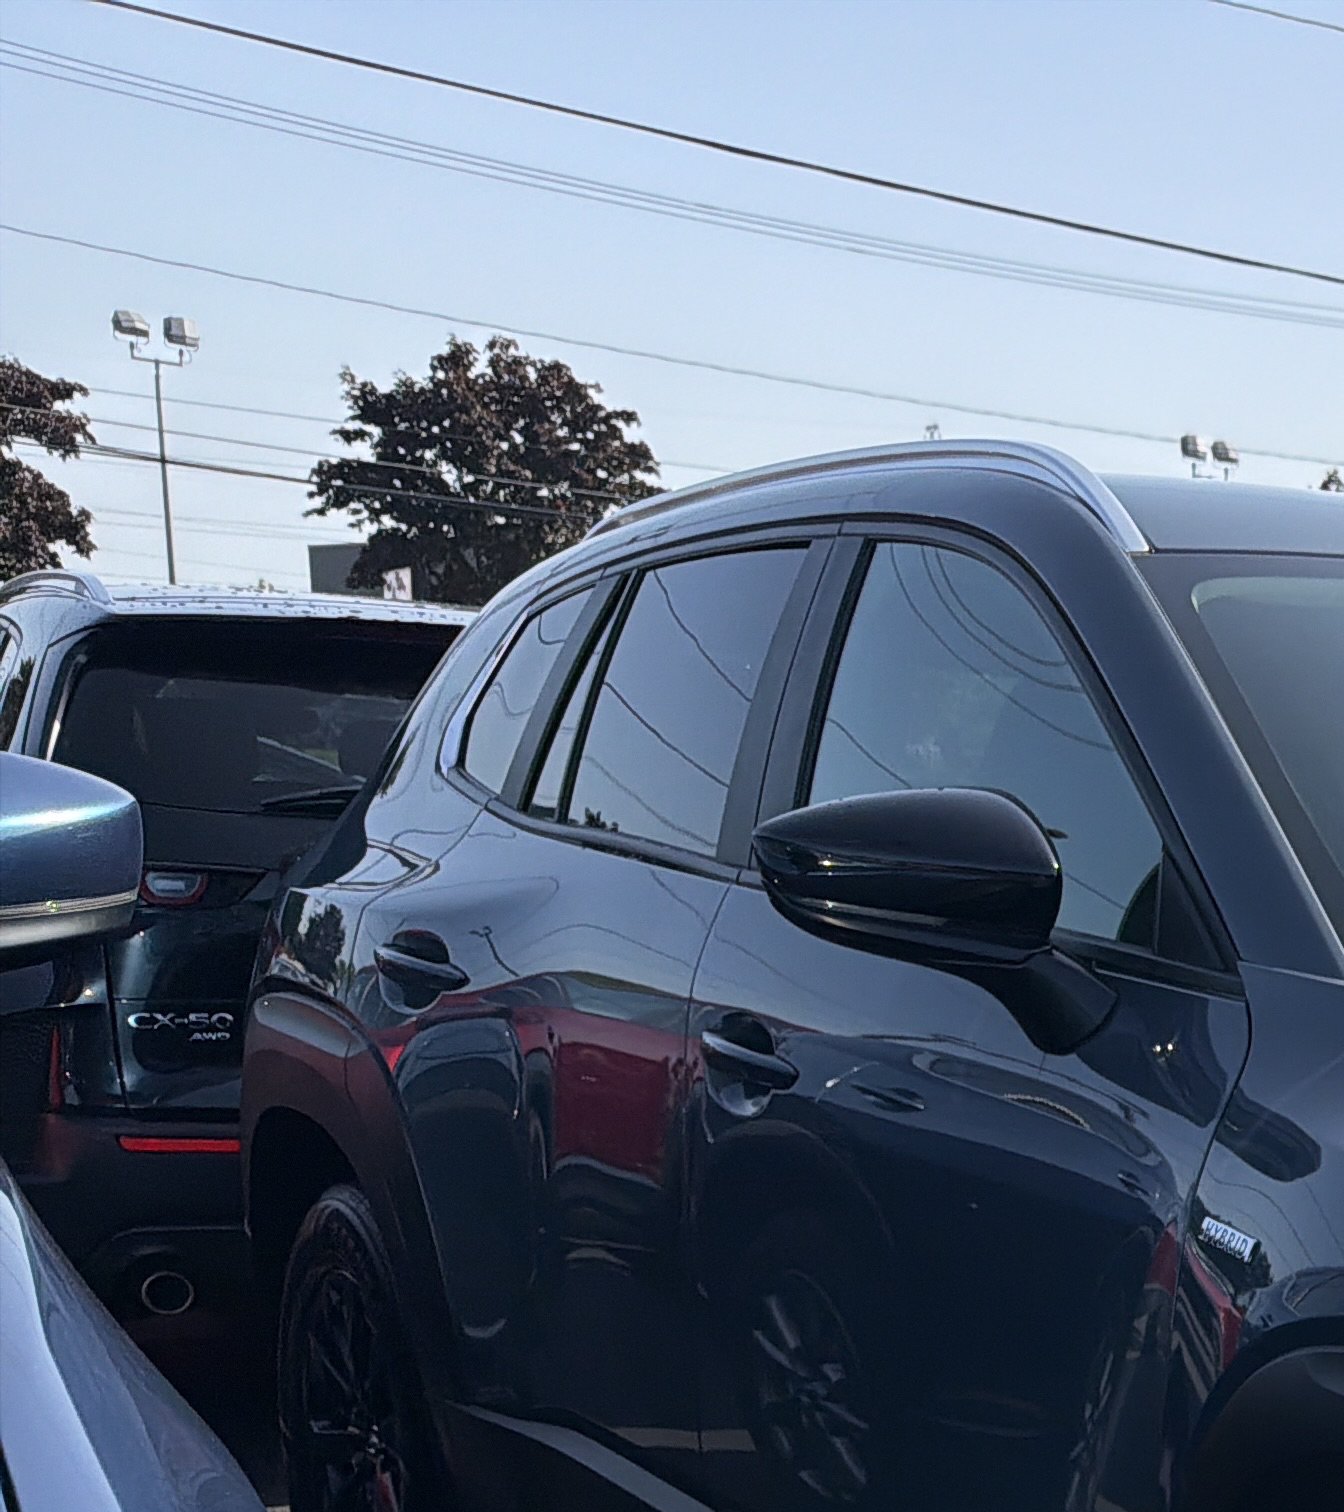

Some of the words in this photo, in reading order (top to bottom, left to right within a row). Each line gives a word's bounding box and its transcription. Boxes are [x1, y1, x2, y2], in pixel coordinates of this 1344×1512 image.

[127, 1011, 235, 1031] CX-50
[189, 1031, 232, 1043] AWD
[1203, 1220, 1250, 1258] HYBRID
